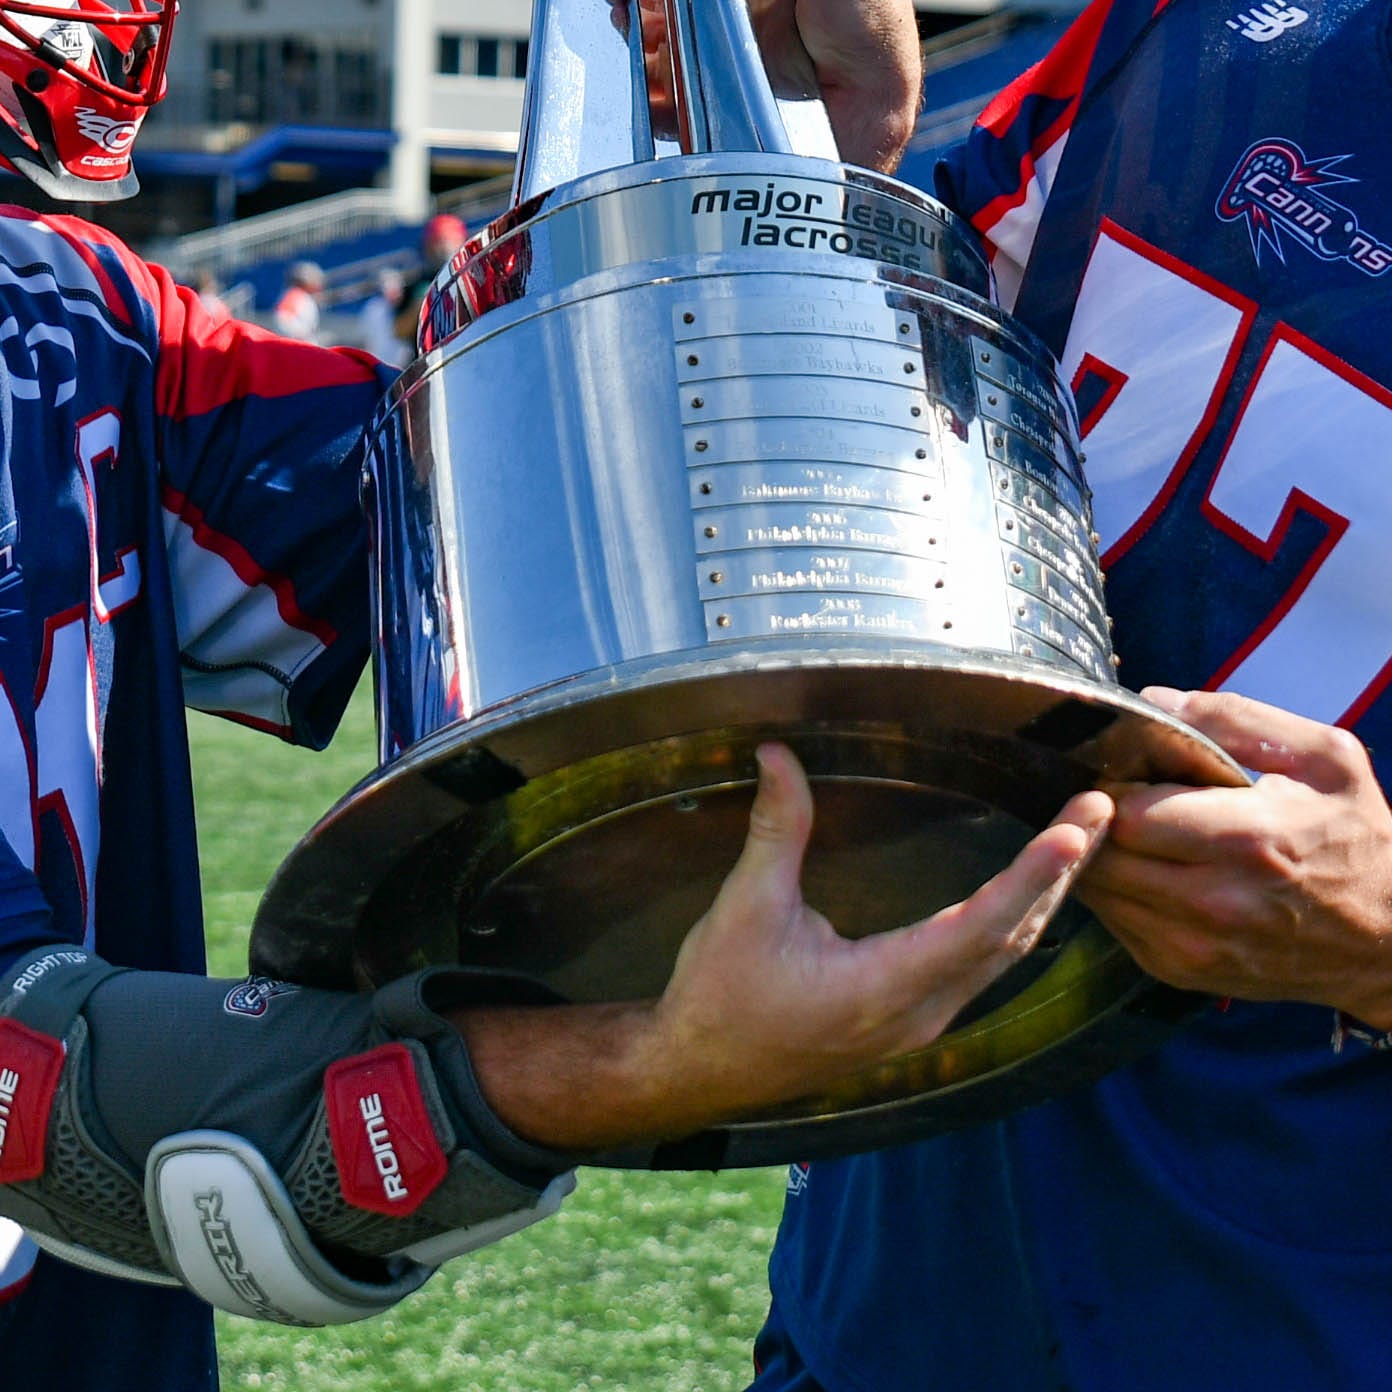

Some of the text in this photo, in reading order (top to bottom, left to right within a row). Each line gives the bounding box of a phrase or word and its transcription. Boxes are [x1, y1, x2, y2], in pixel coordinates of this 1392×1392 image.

[691, 183, 822, 218] major
[741, 216, 921, 270] lacrosse
[13, 954, 61, 993] RIGHT
[359, 1093, 409, 1200] ROME
